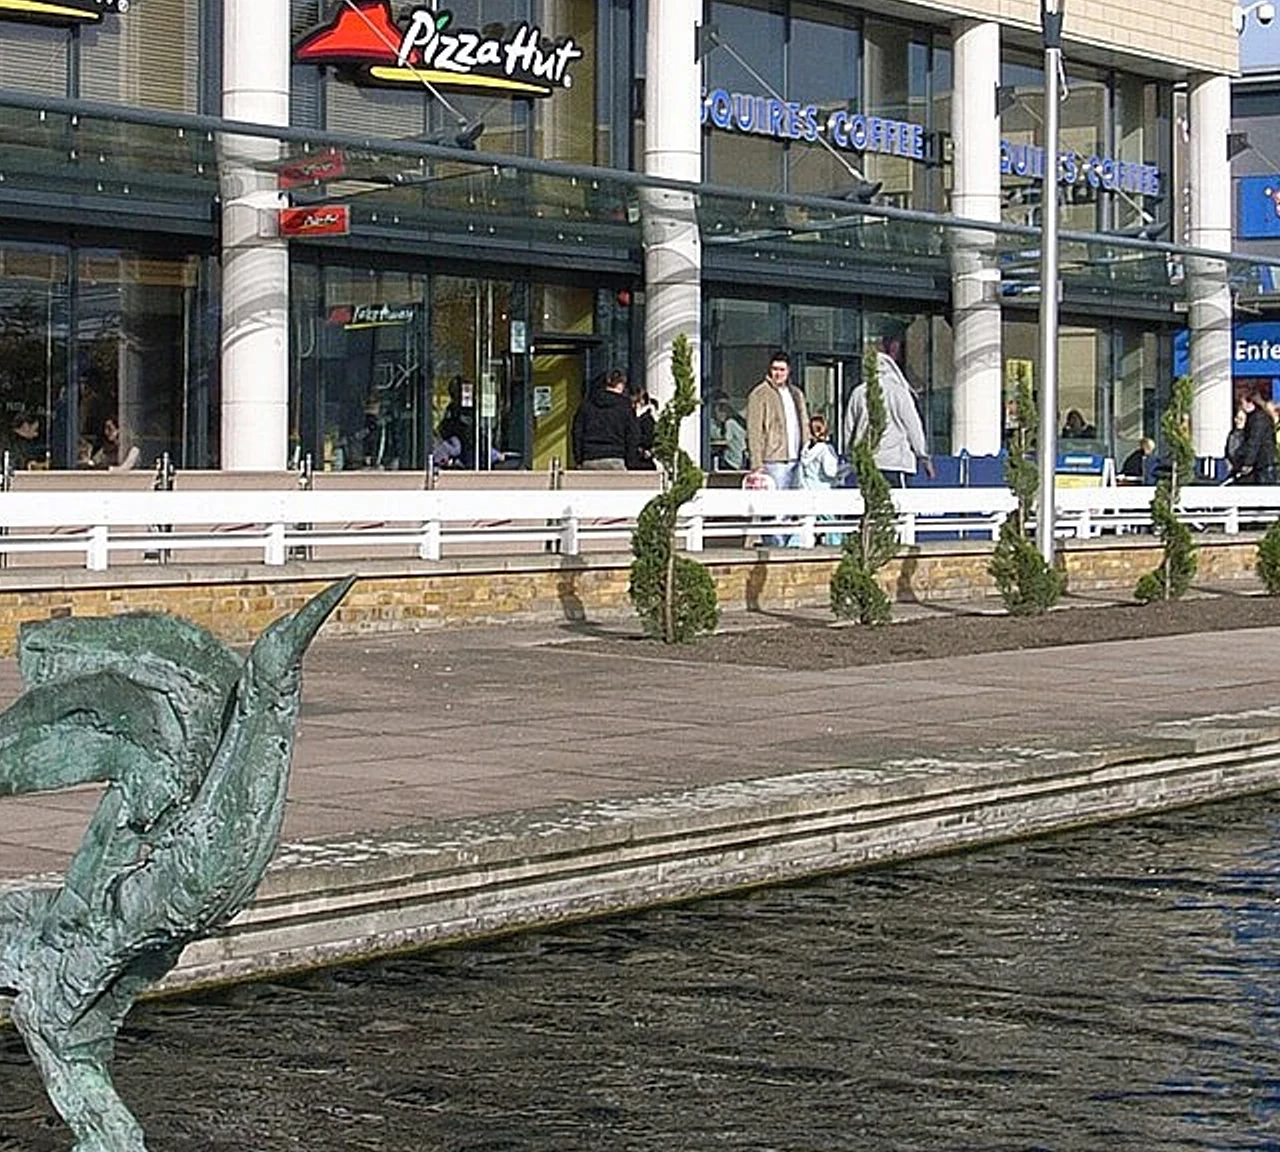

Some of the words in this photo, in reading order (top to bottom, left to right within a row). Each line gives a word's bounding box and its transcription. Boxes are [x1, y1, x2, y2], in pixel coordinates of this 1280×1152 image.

[397, 9, 502, 73] Pizza
[503, 24, 582, 81] Hut
[832, 110, 925, 160] COFFEE
